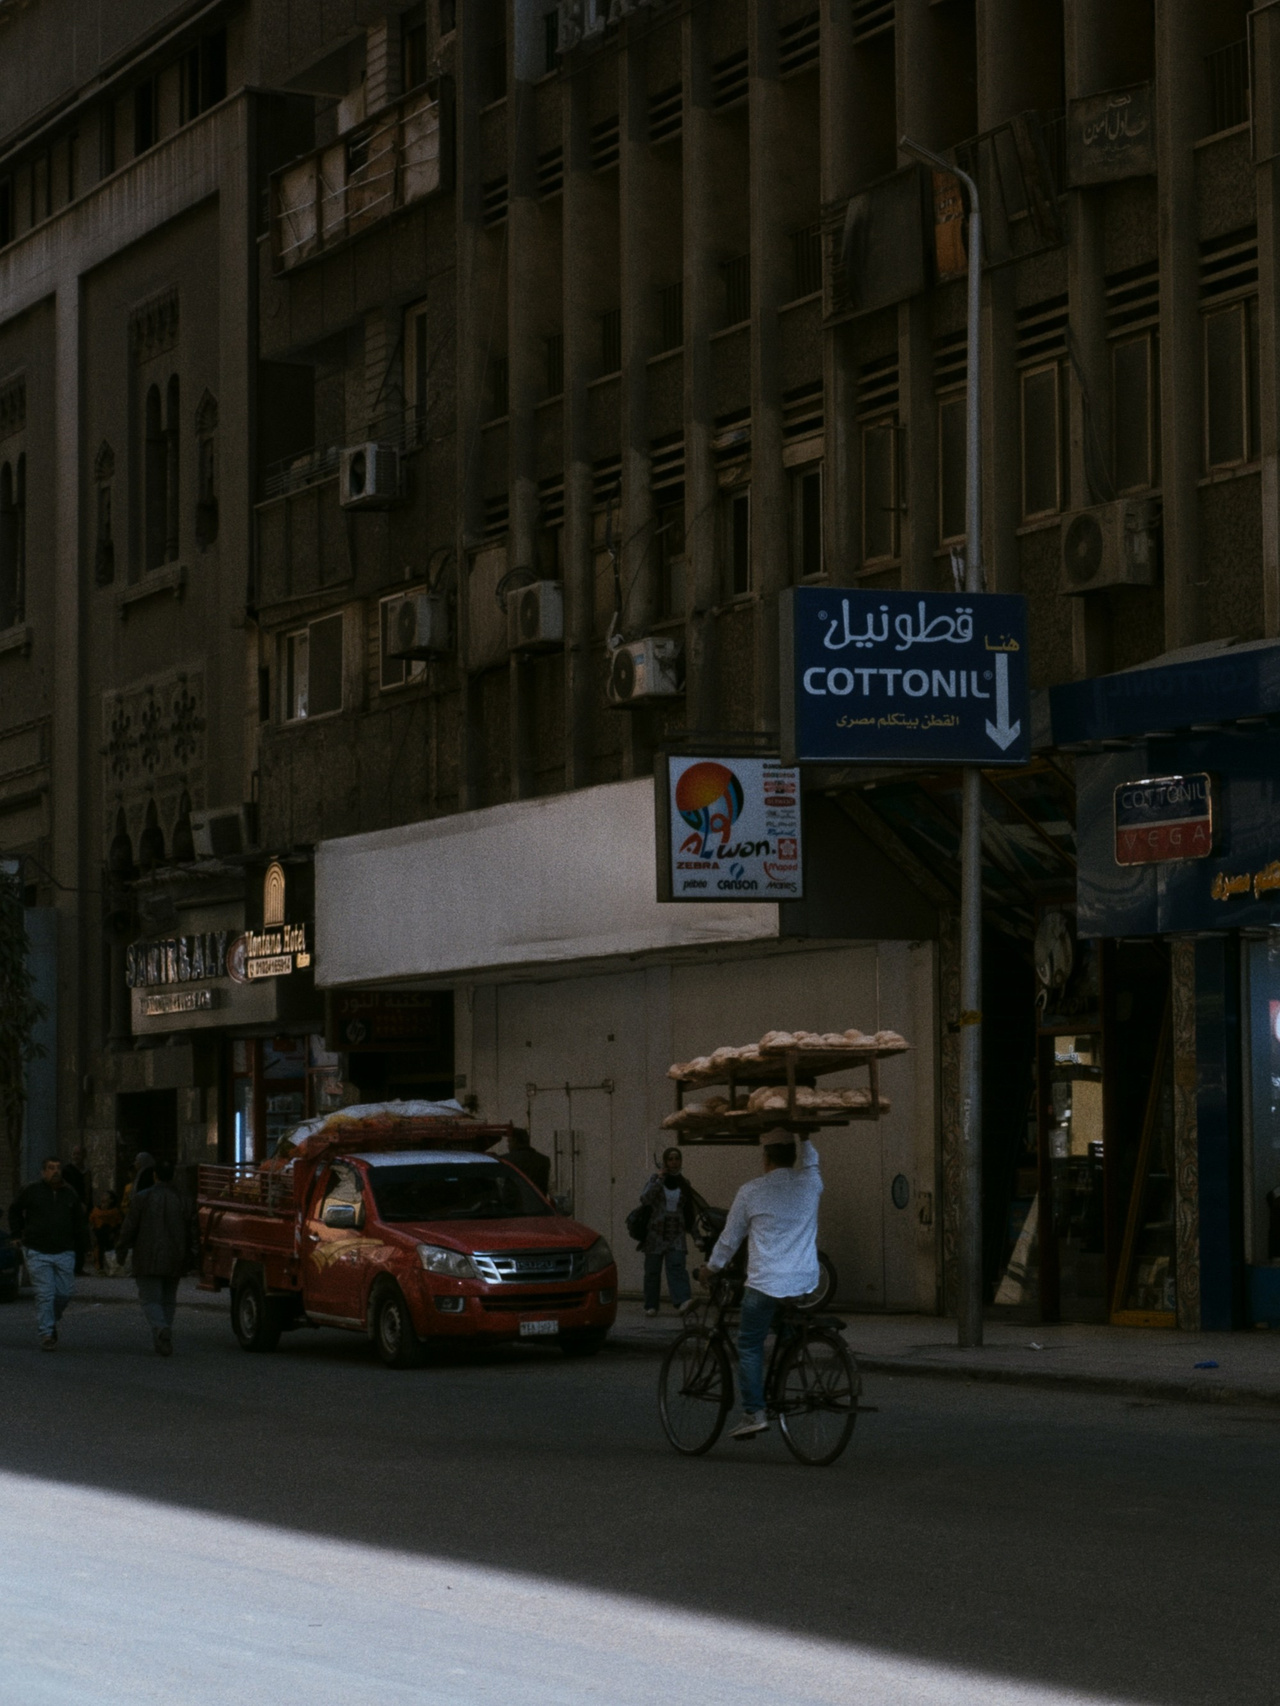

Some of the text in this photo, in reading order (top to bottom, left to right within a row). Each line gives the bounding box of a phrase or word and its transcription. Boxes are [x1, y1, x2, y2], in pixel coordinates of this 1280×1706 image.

[823, 598, 973, 651] قطونيل
[803, 666, 991, 699] COTTONIL
[877, 712, 920, 729] بيتكلم
[921, 714, 960, 730] القطن
[1120, 781, 1209, 811] COTTONIL
[676, 861, 720, 870] ZEBRA
[283, 922, 307, 954] Hotel
